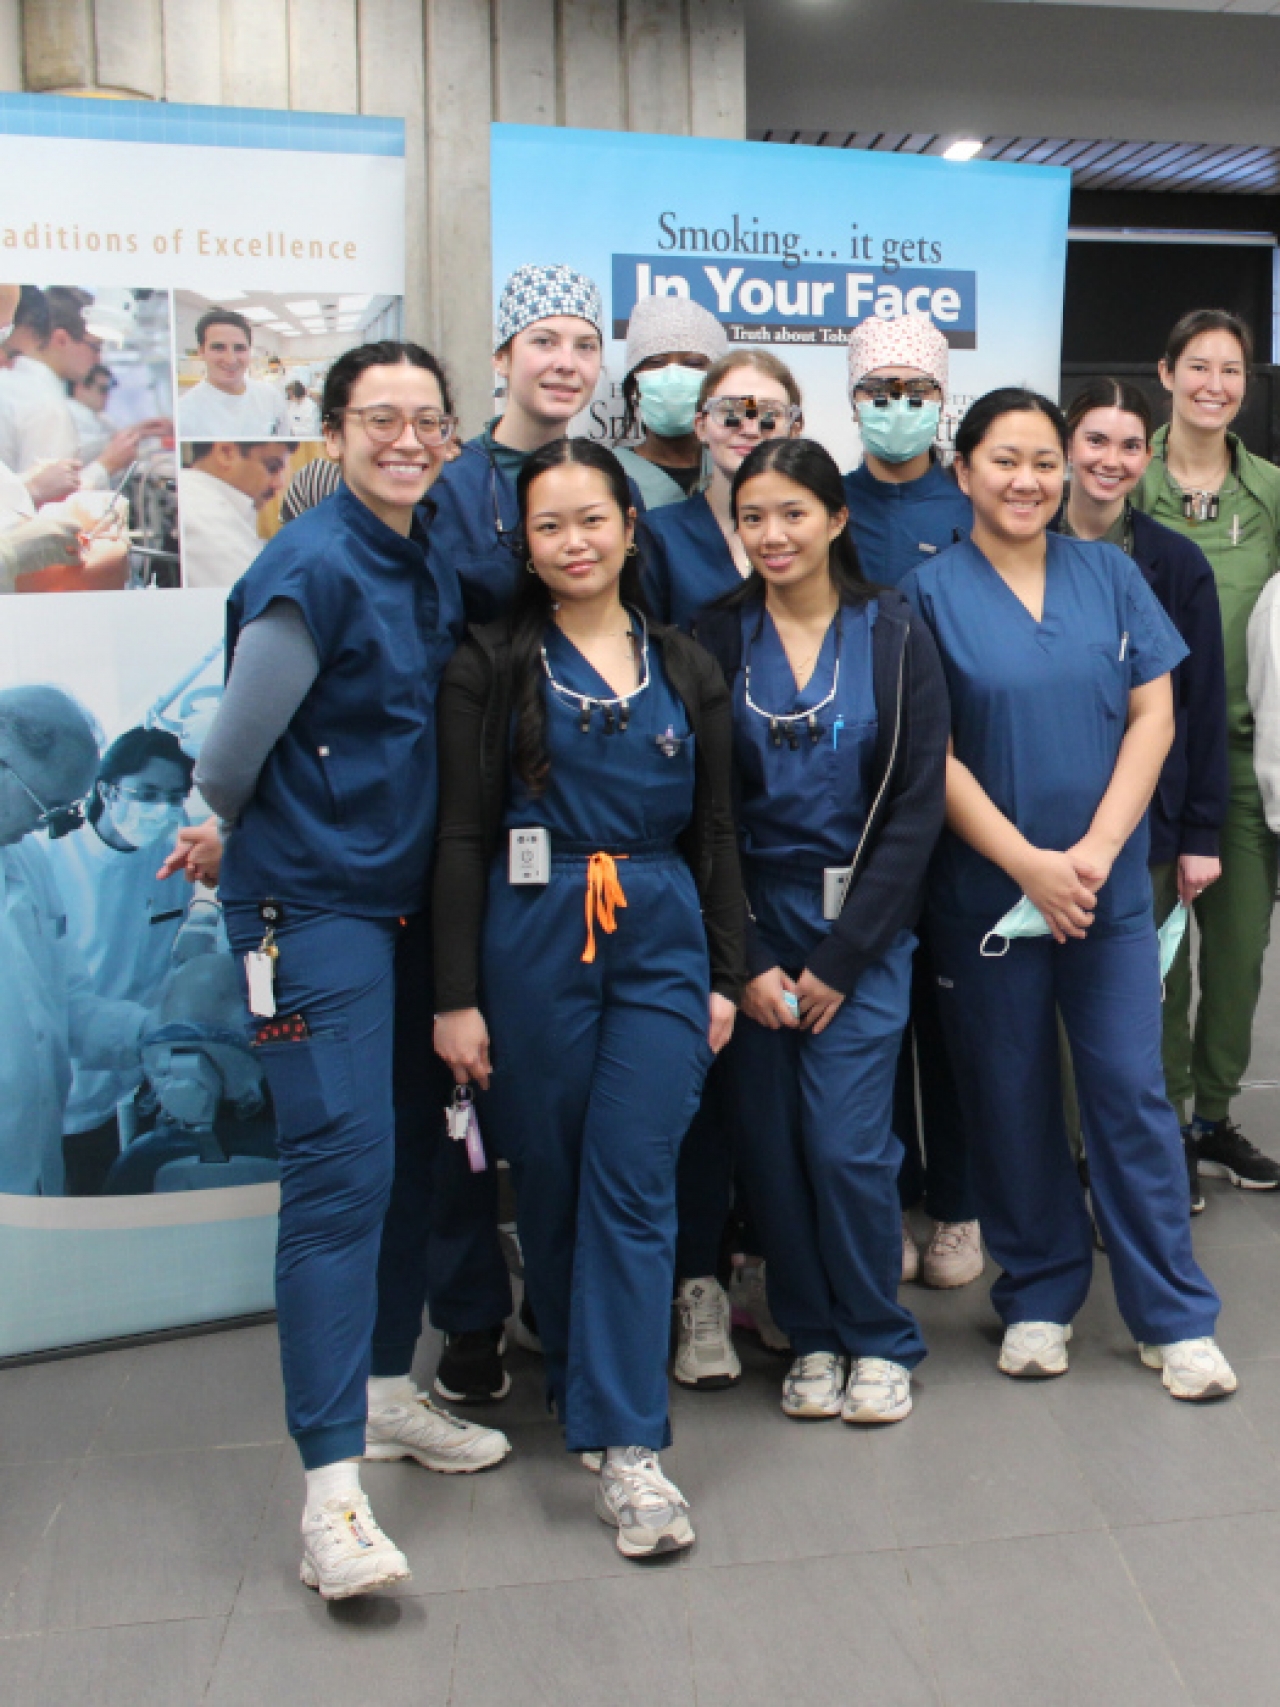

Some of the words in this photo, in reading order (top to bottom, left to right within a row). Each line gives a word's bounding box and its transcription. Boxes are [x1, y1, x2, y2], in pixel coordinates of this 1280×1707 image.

[3, 221, 140, 253] aditions
[153, 228, 184, 255] of
[198, 228, 358, 260] Excellence
[850, 221, 873, 260] it
[882, 236, 943, 276] gets
[702, 265, 835, 316] Your
[846, 272, 961, 323] Face
[729, 324, 772, 340] Truth
[774, 326, 815, 342] about
